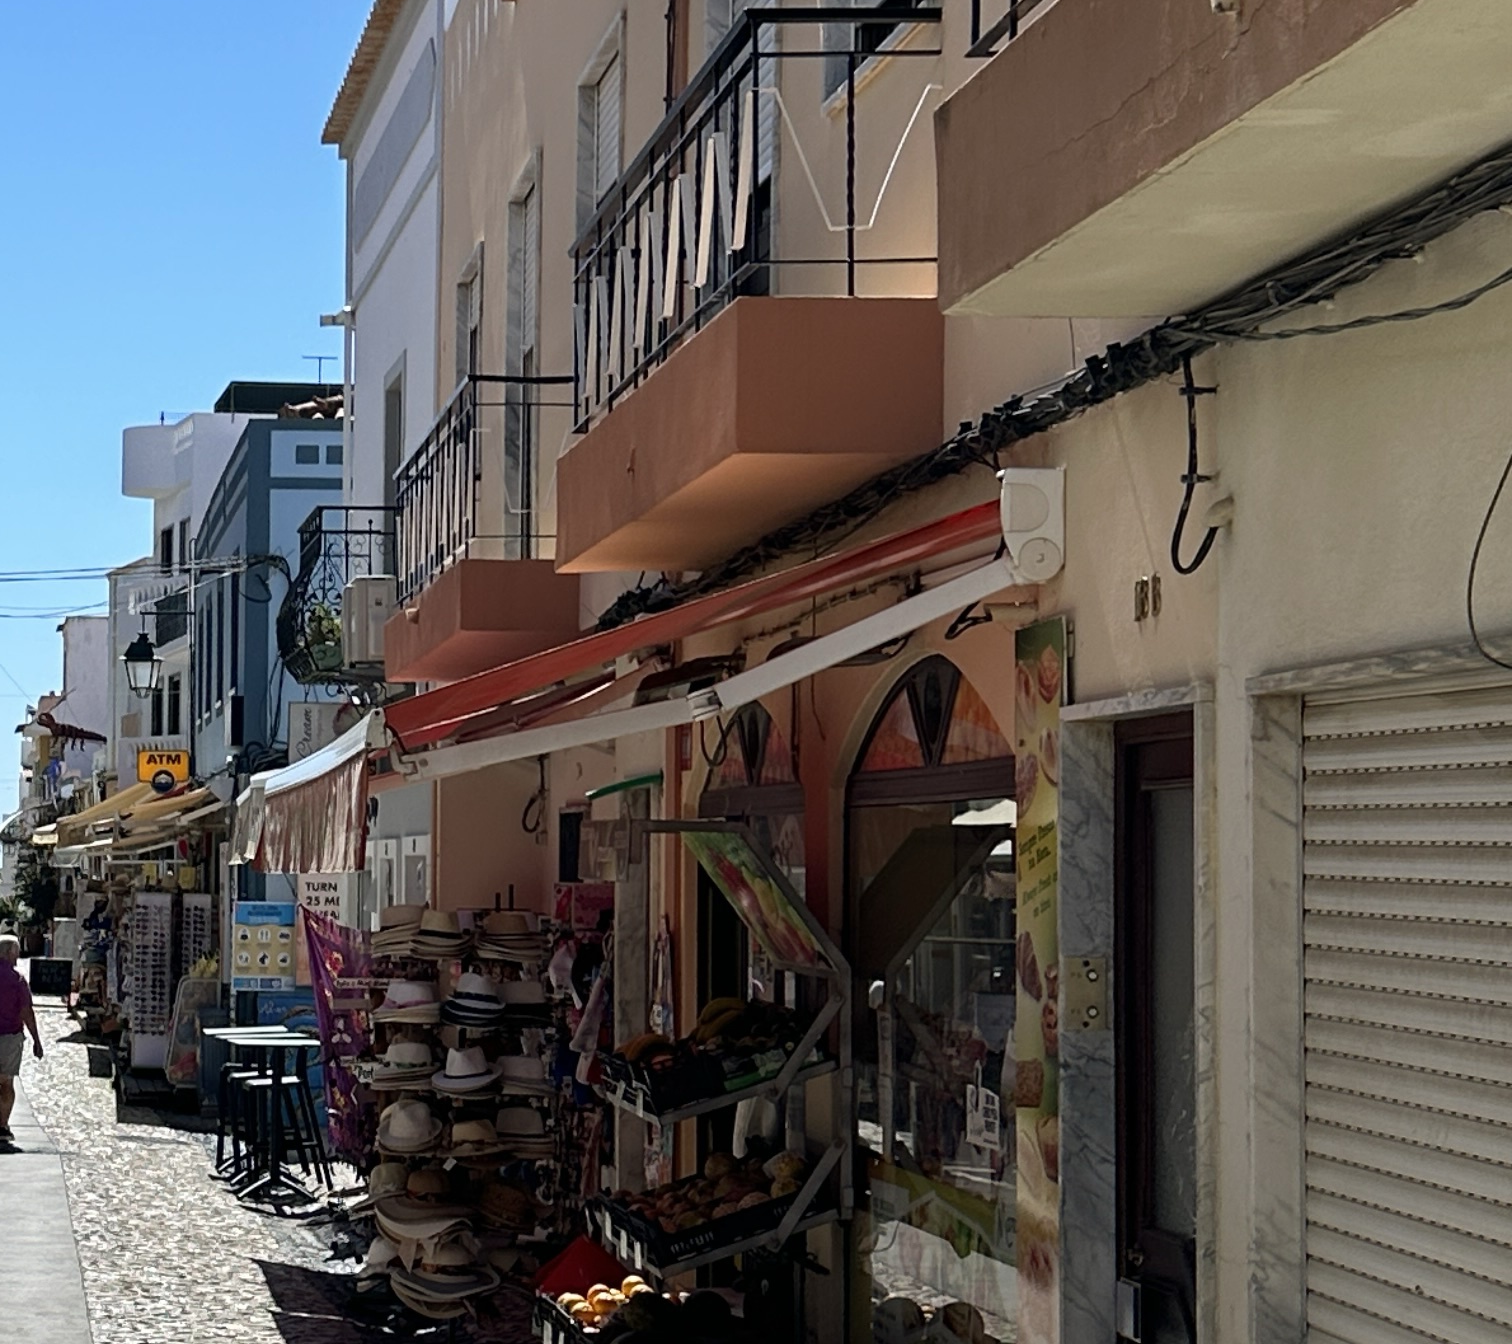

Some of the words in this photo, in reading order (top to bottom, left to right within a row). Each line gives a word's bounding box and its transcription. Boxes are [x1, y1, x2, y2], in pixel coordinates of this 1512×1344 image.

[146, 754, 181, 765] ATM
[305, 881, 338, 893] TURN
[306, 896, 320, 906] 25
